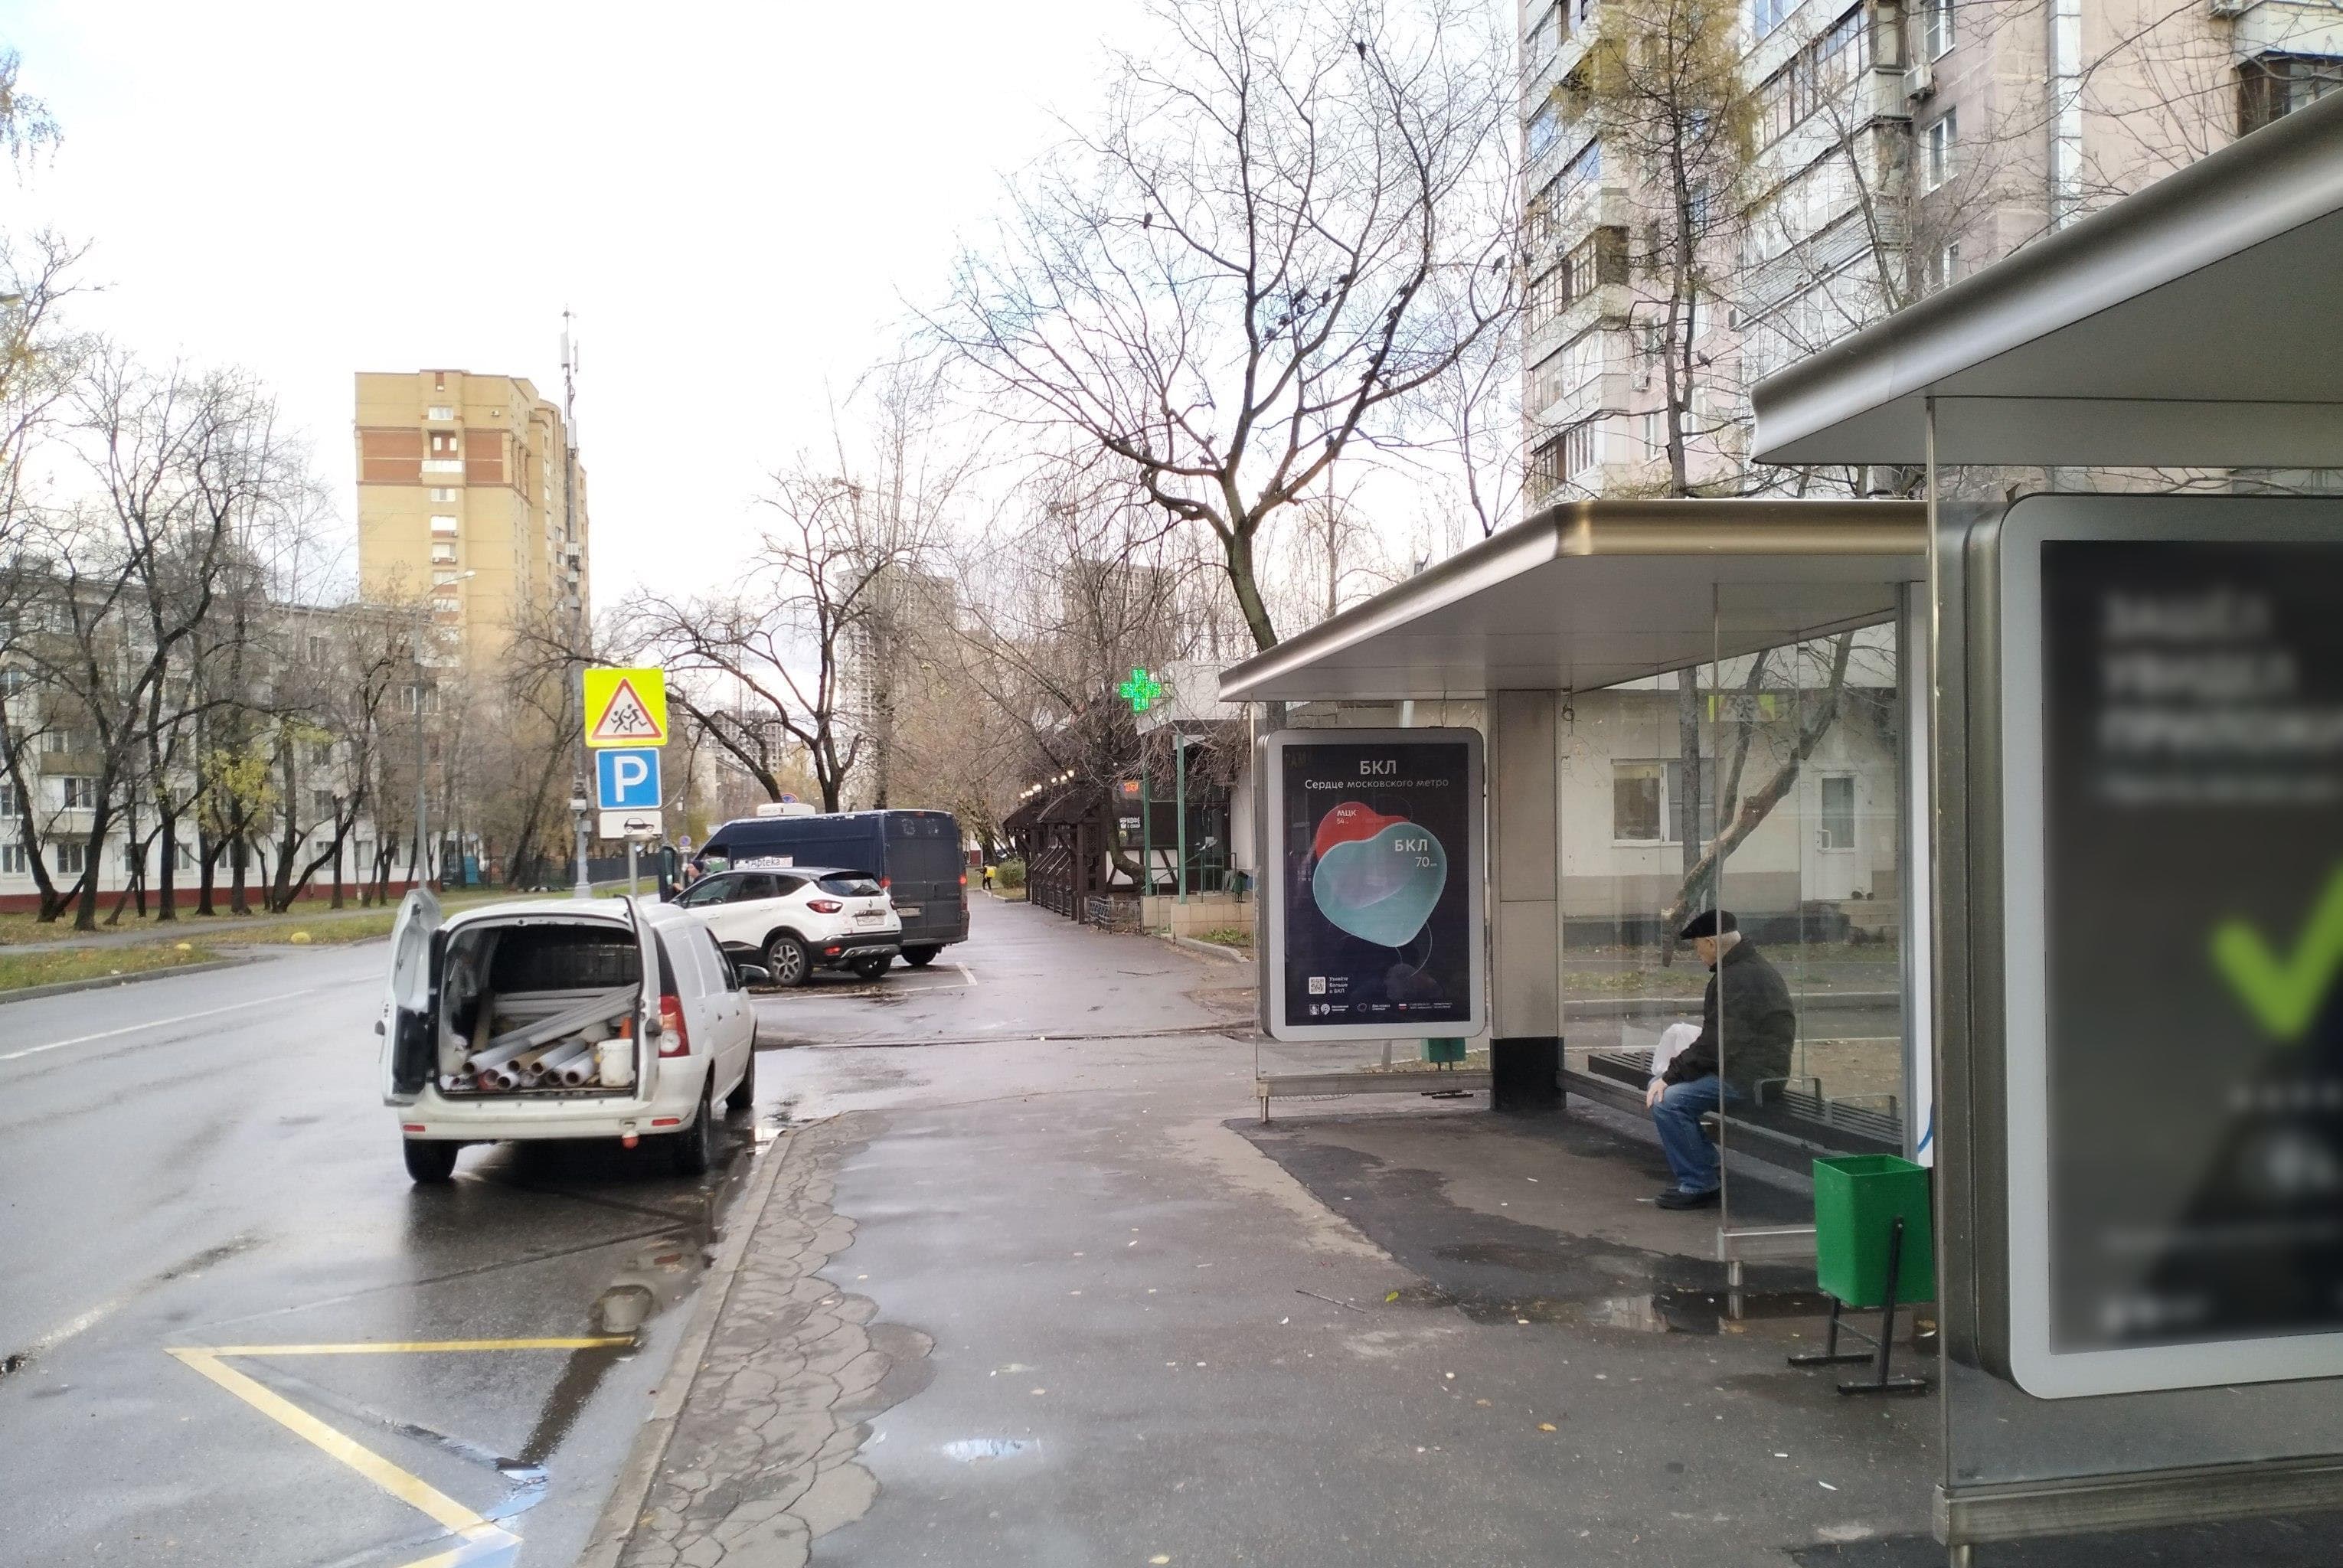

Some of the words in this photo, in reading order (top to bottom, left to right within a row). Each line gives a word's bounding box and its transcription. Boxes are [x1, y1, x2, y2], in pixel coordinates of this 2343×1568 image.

[1360, 760, 1397, 776] БКЛ
[614, 755, 648, 802] P
[1305, 779, 1344, 791] Сердце
[1347, 779, 1413, 789] московского
[1417, 779, 1449, 789] метро
[1394, 839, 1428, 852] БКЛ
[1415, 857, 1430, 867] 70
